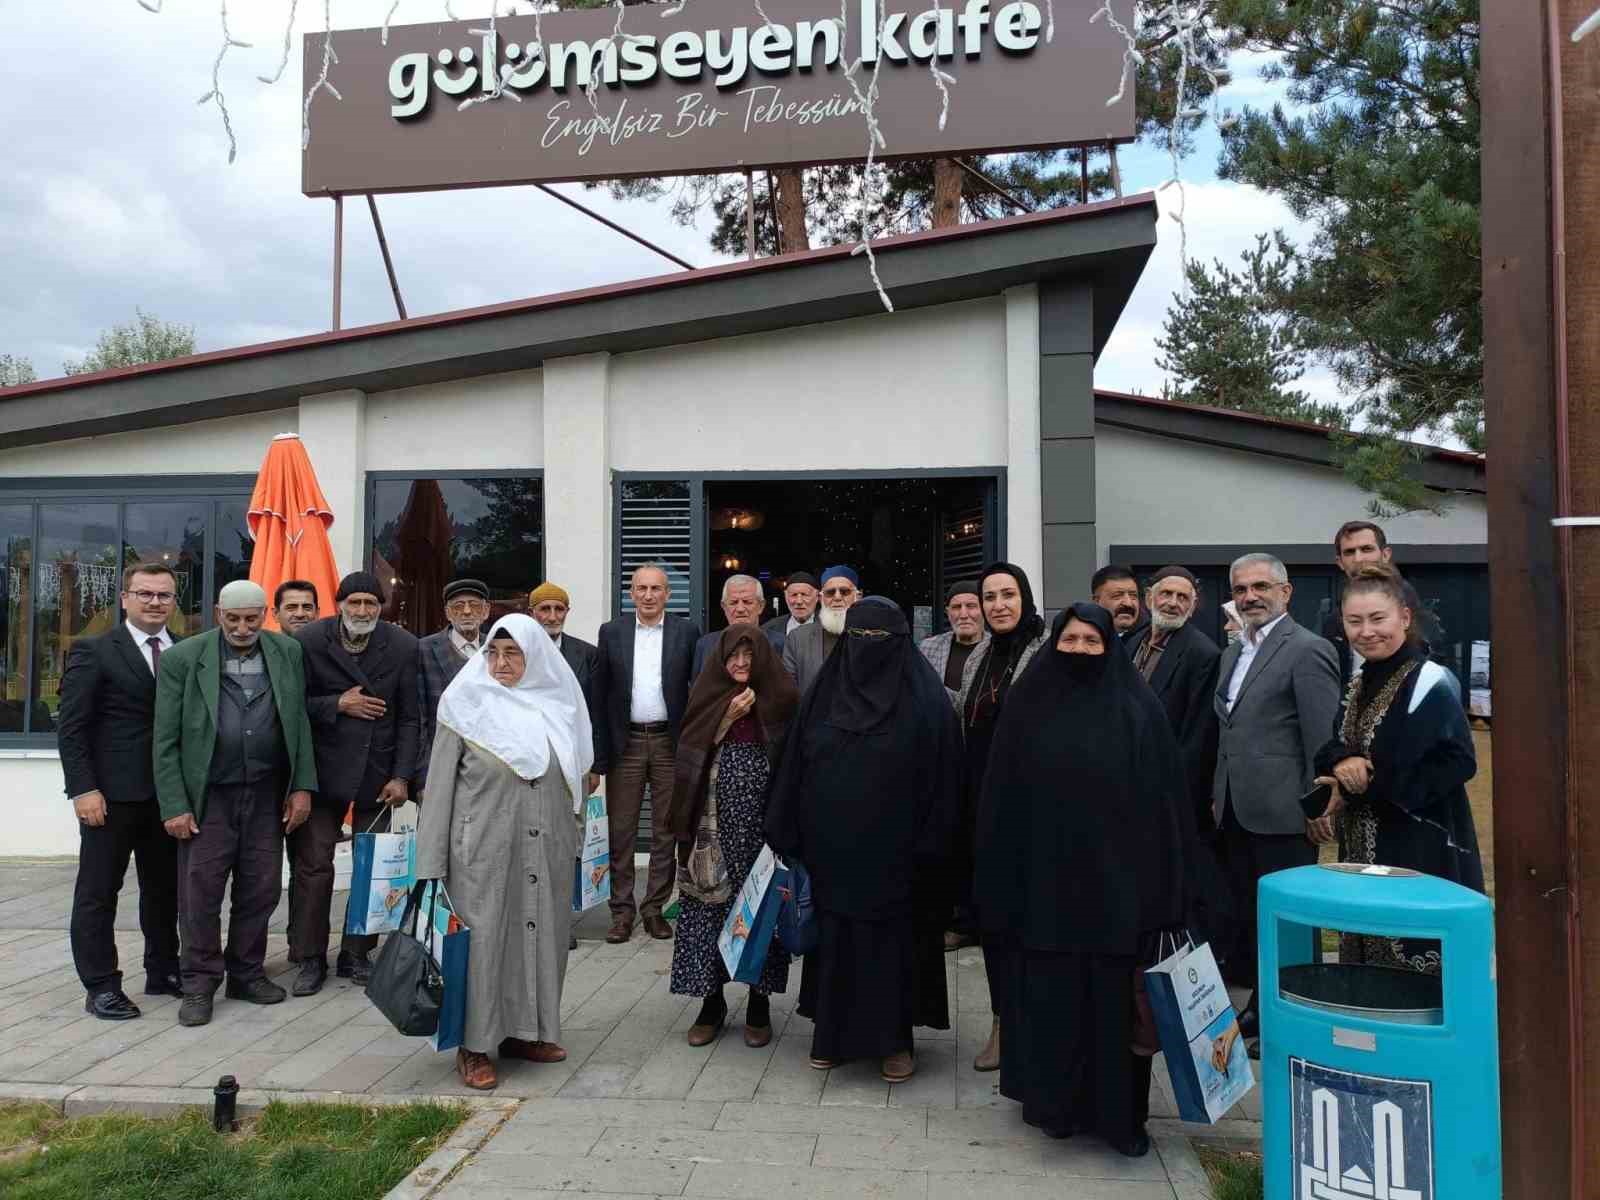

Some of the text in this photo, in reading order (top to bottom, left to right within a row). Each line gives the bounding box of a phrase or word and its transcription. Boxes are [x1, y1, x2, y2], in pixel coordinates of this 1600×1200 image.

[861, 0, 1042, 62] kafe
[541, 85, 870, 156] Engelsiz Bir Tebessüm
